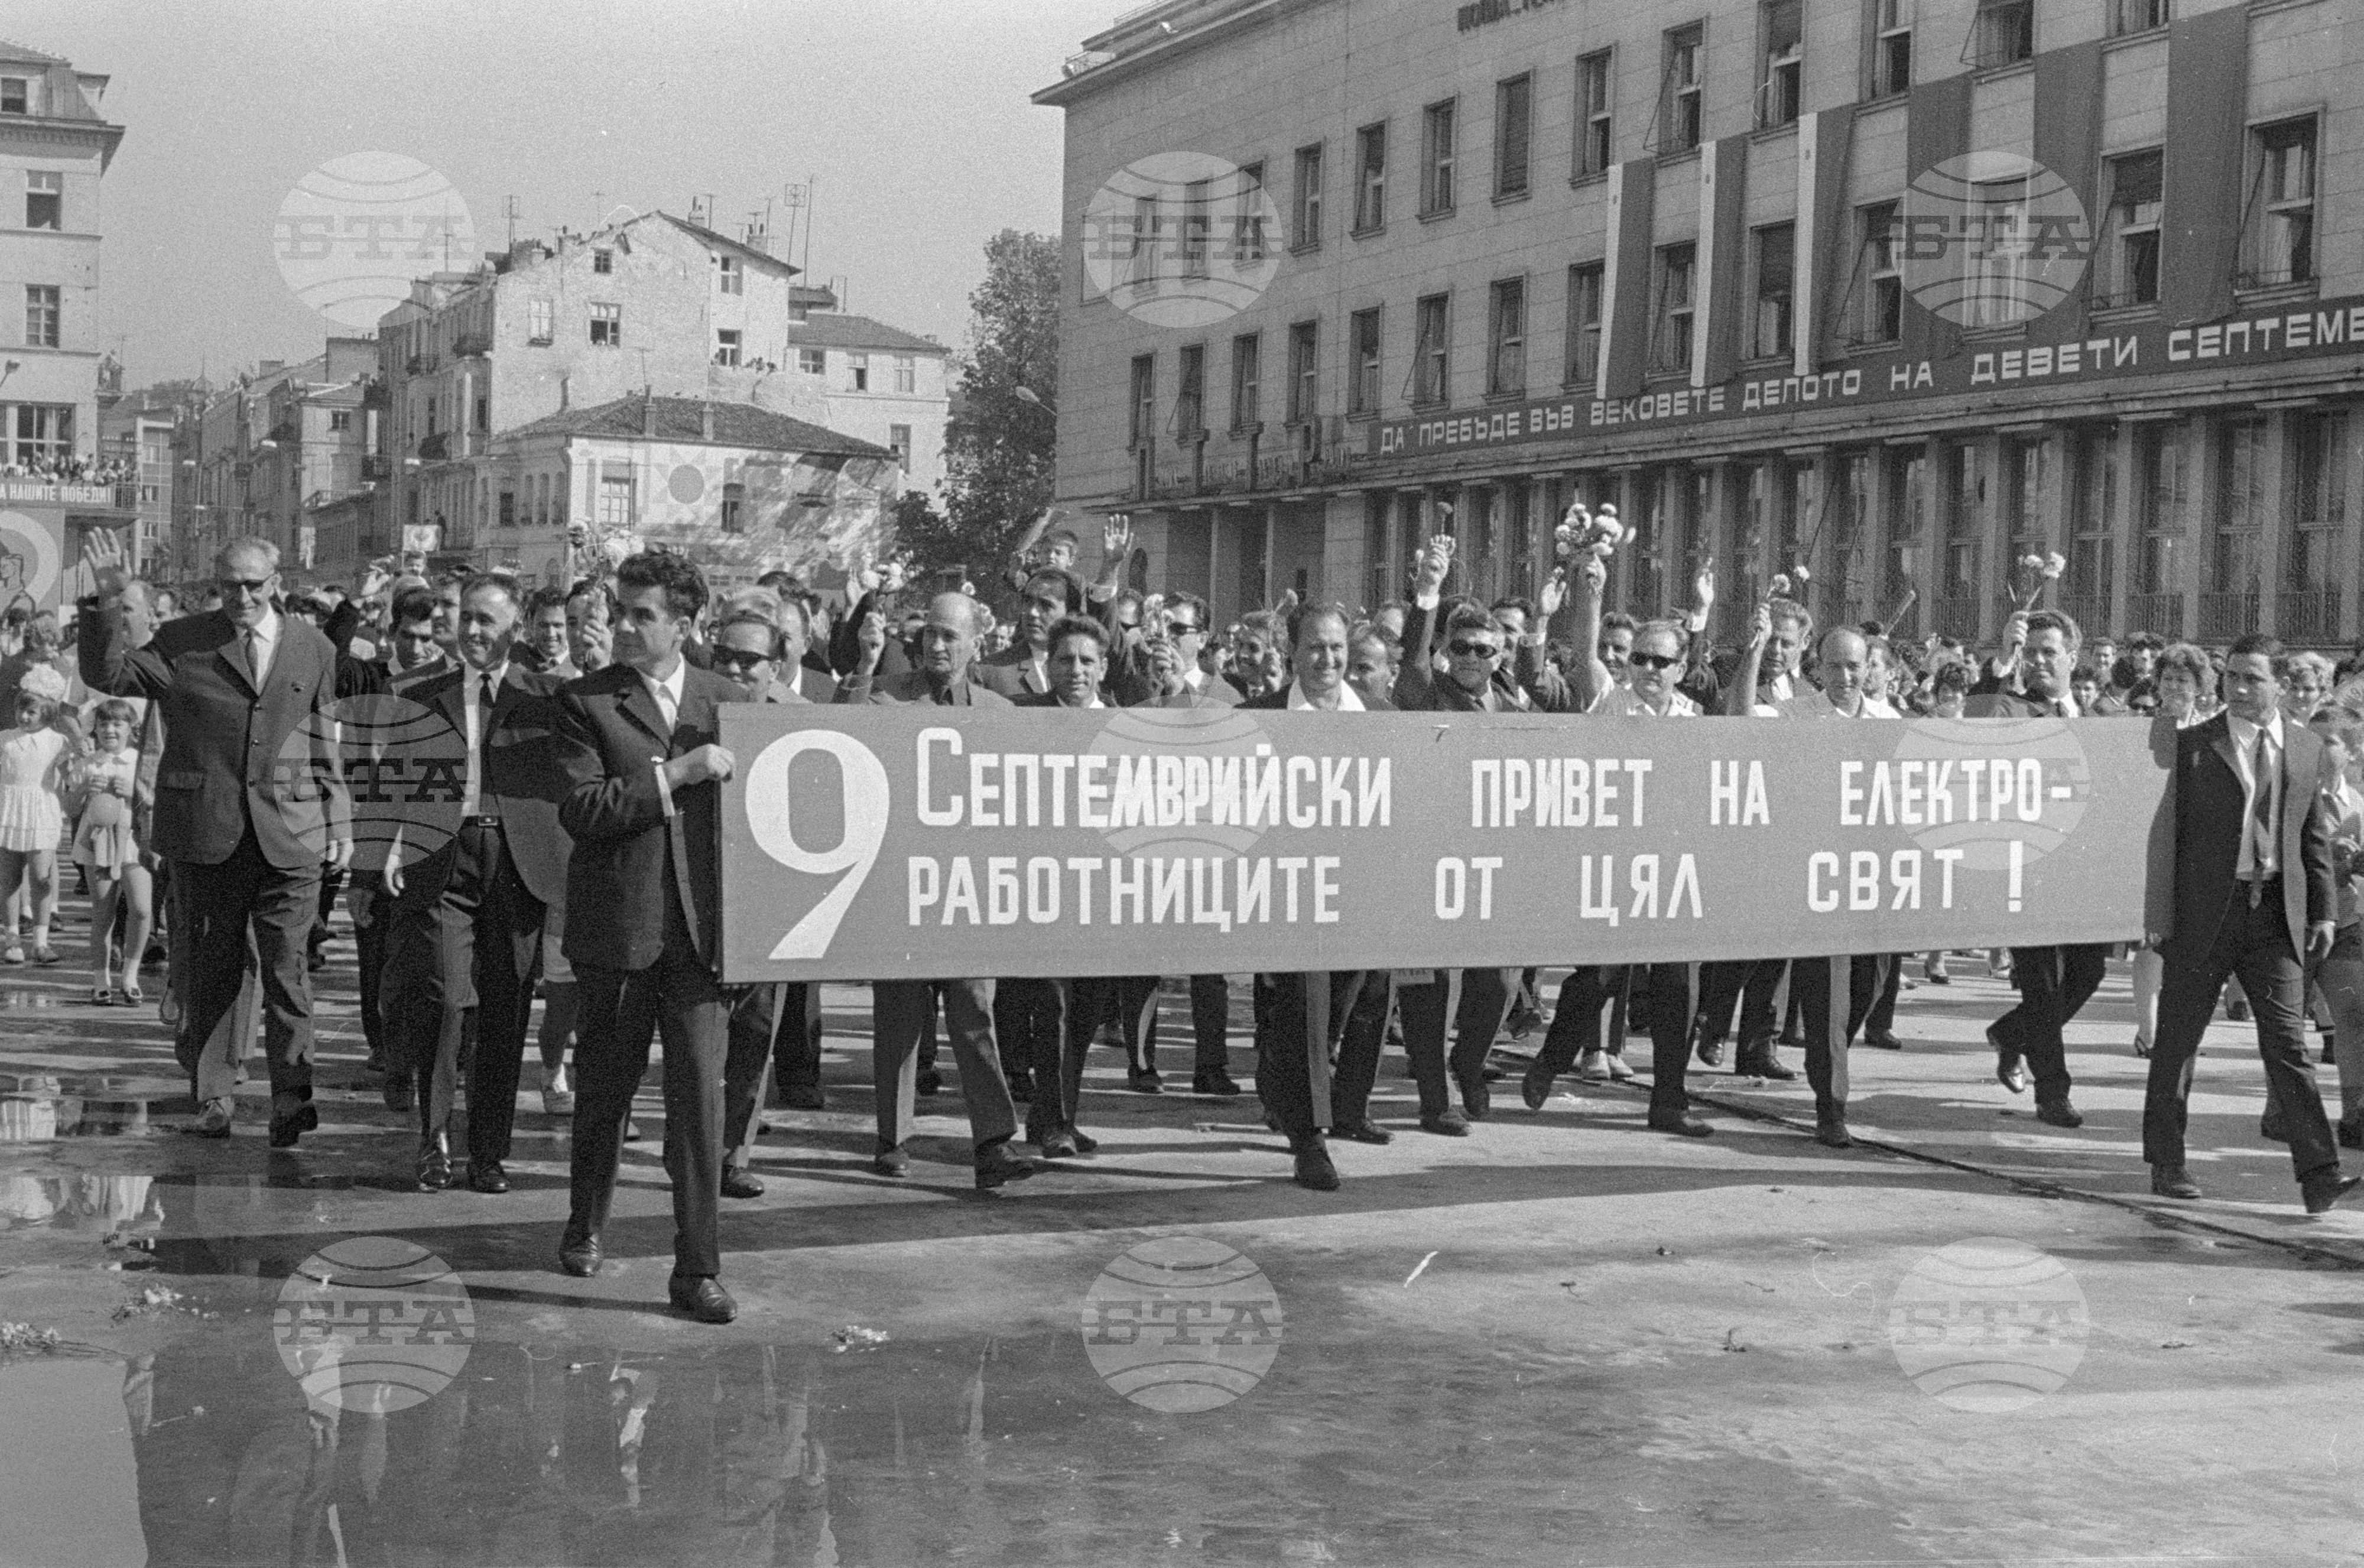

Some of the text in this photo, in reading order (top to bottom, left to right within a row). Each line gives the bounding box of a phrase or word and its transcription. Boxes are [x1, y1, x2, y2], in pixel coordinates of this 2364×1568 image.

[1381, 427, 1404, 455] ДА
[1420, 412, 1520, 447] ПРЕБЪДЕ
[1531, 405, 1574, 433] ВЪВ
[1591, 387, 1725, 426] ВЕКОВЕТЕ
[1891, 361, 1934, 391] НА
[1971, 336, 2138, 385] ДЕВЕТИ
[745, 729, 890, 960] 9
[1471, 757, 1653, 828] ПРИВЕТ
[1710, 760, 1770, 826] НА
[1840, 758, 2071, 826] ЕЛЕКТРО-
[908, 856, 1341, 933] РАБОТНИЦИТЕ
[1435, 856, 1503, 920] ОТ
[1580, 853, 1703, 927] ЦЯЛ
